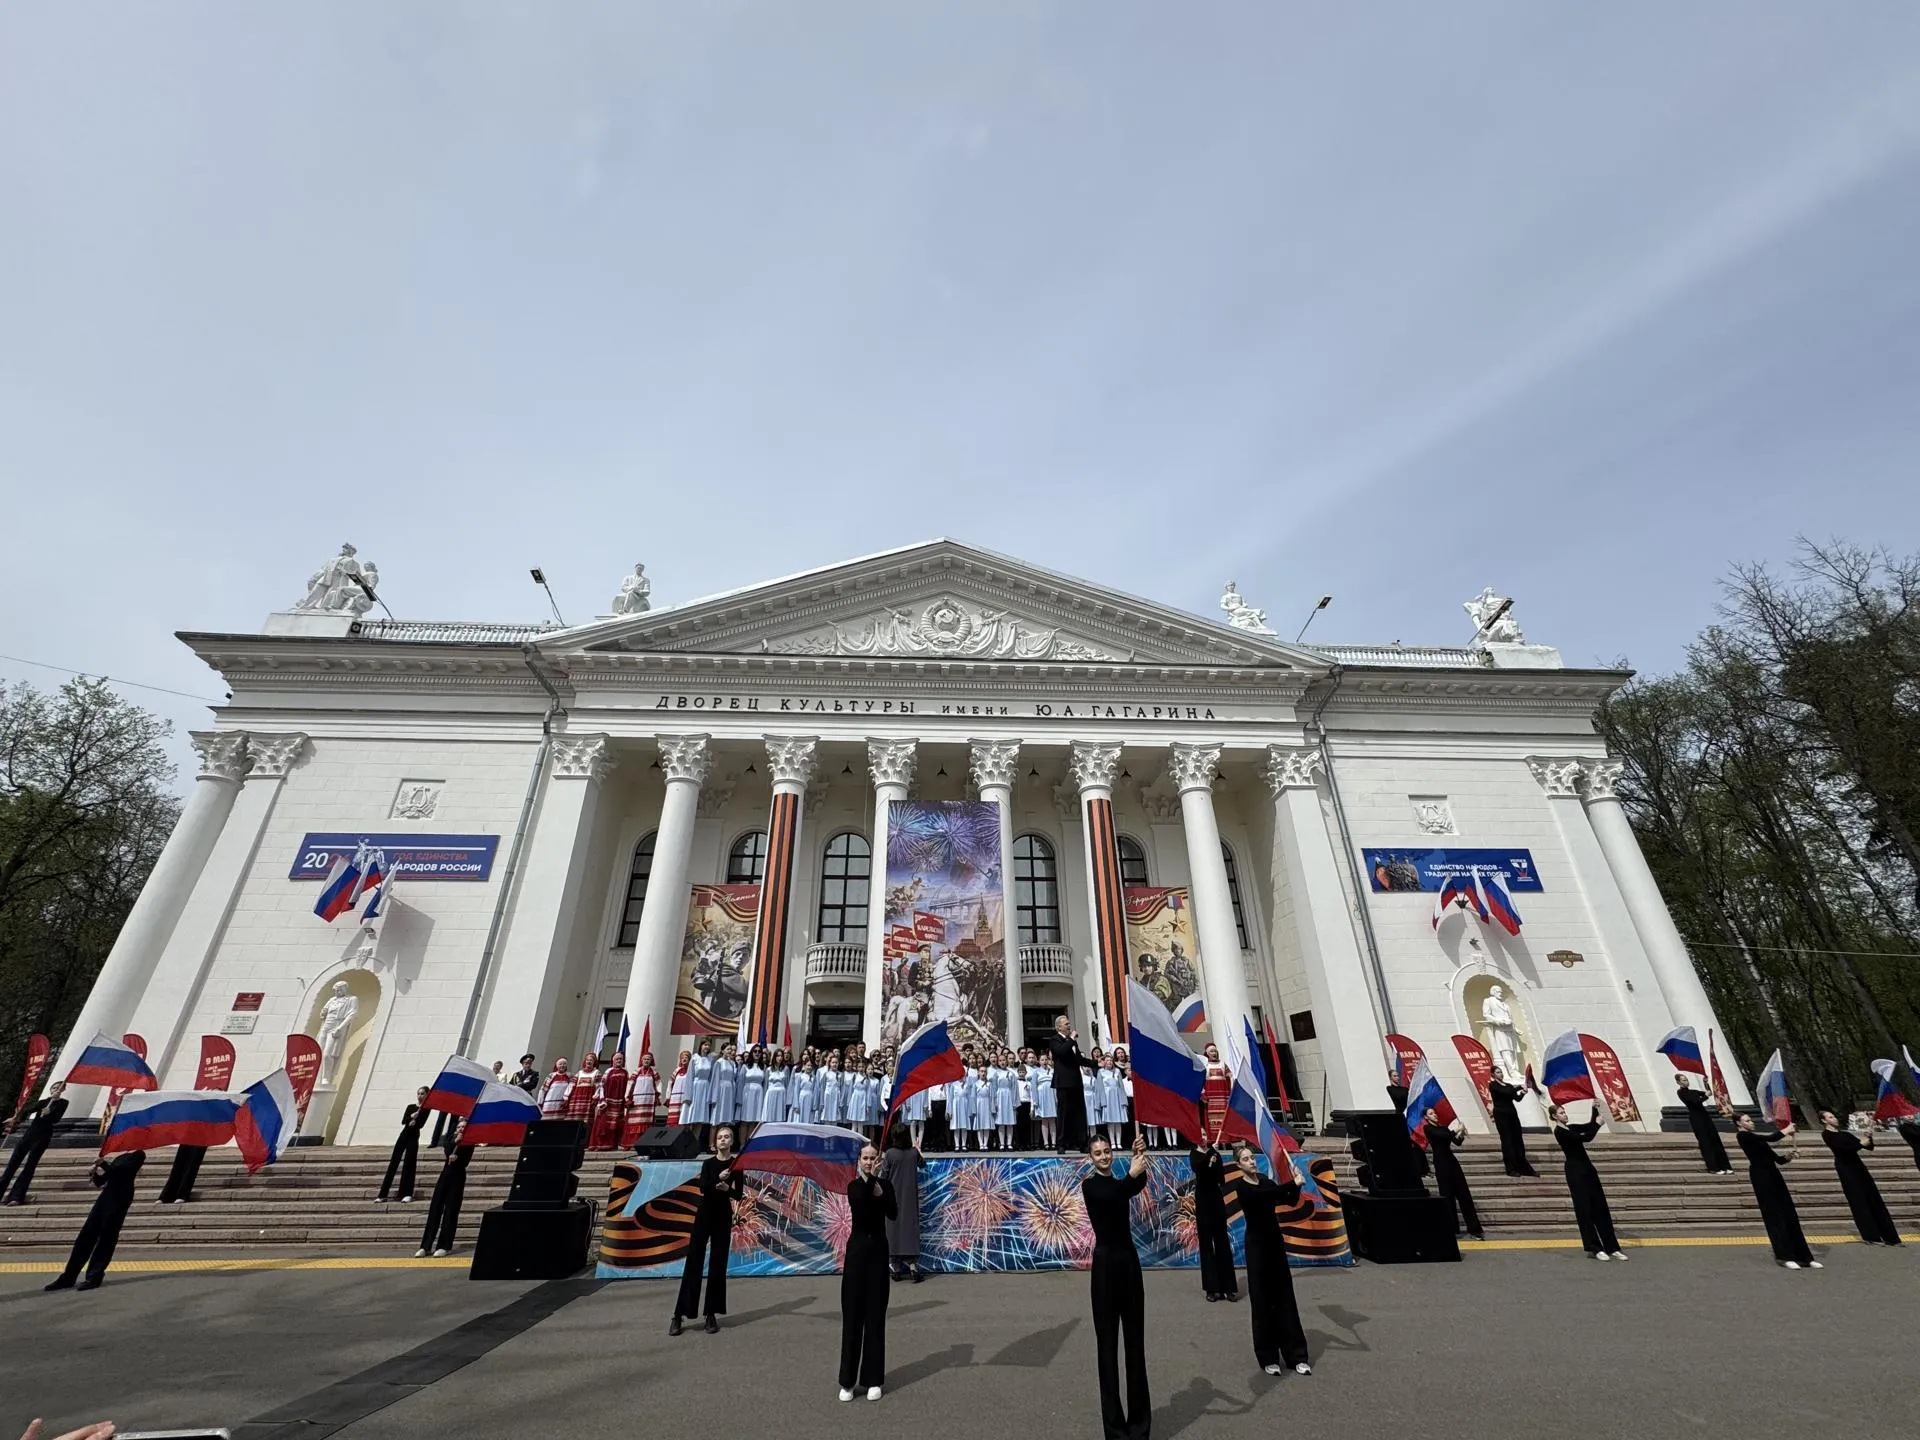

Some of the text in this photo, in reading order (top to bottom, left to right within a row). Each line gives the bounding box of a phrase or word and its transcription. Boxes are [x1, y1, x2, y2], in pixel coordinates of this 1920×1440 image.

[656, 696, 761, 711] ДВОРЕЦ
[780, 698, 915, 714] КУЛЬТУРЫ
[1091, 705, 1217, 720] ГАГАРИНА
[416, 852, 468, 861] ЕДИНСТВА
[439, 863, 482, 872] РОССИИ
[205, 1054, 231, 1065] 9 МАЯ
[292, 1053, 317, 1064] 9 МАЯ
